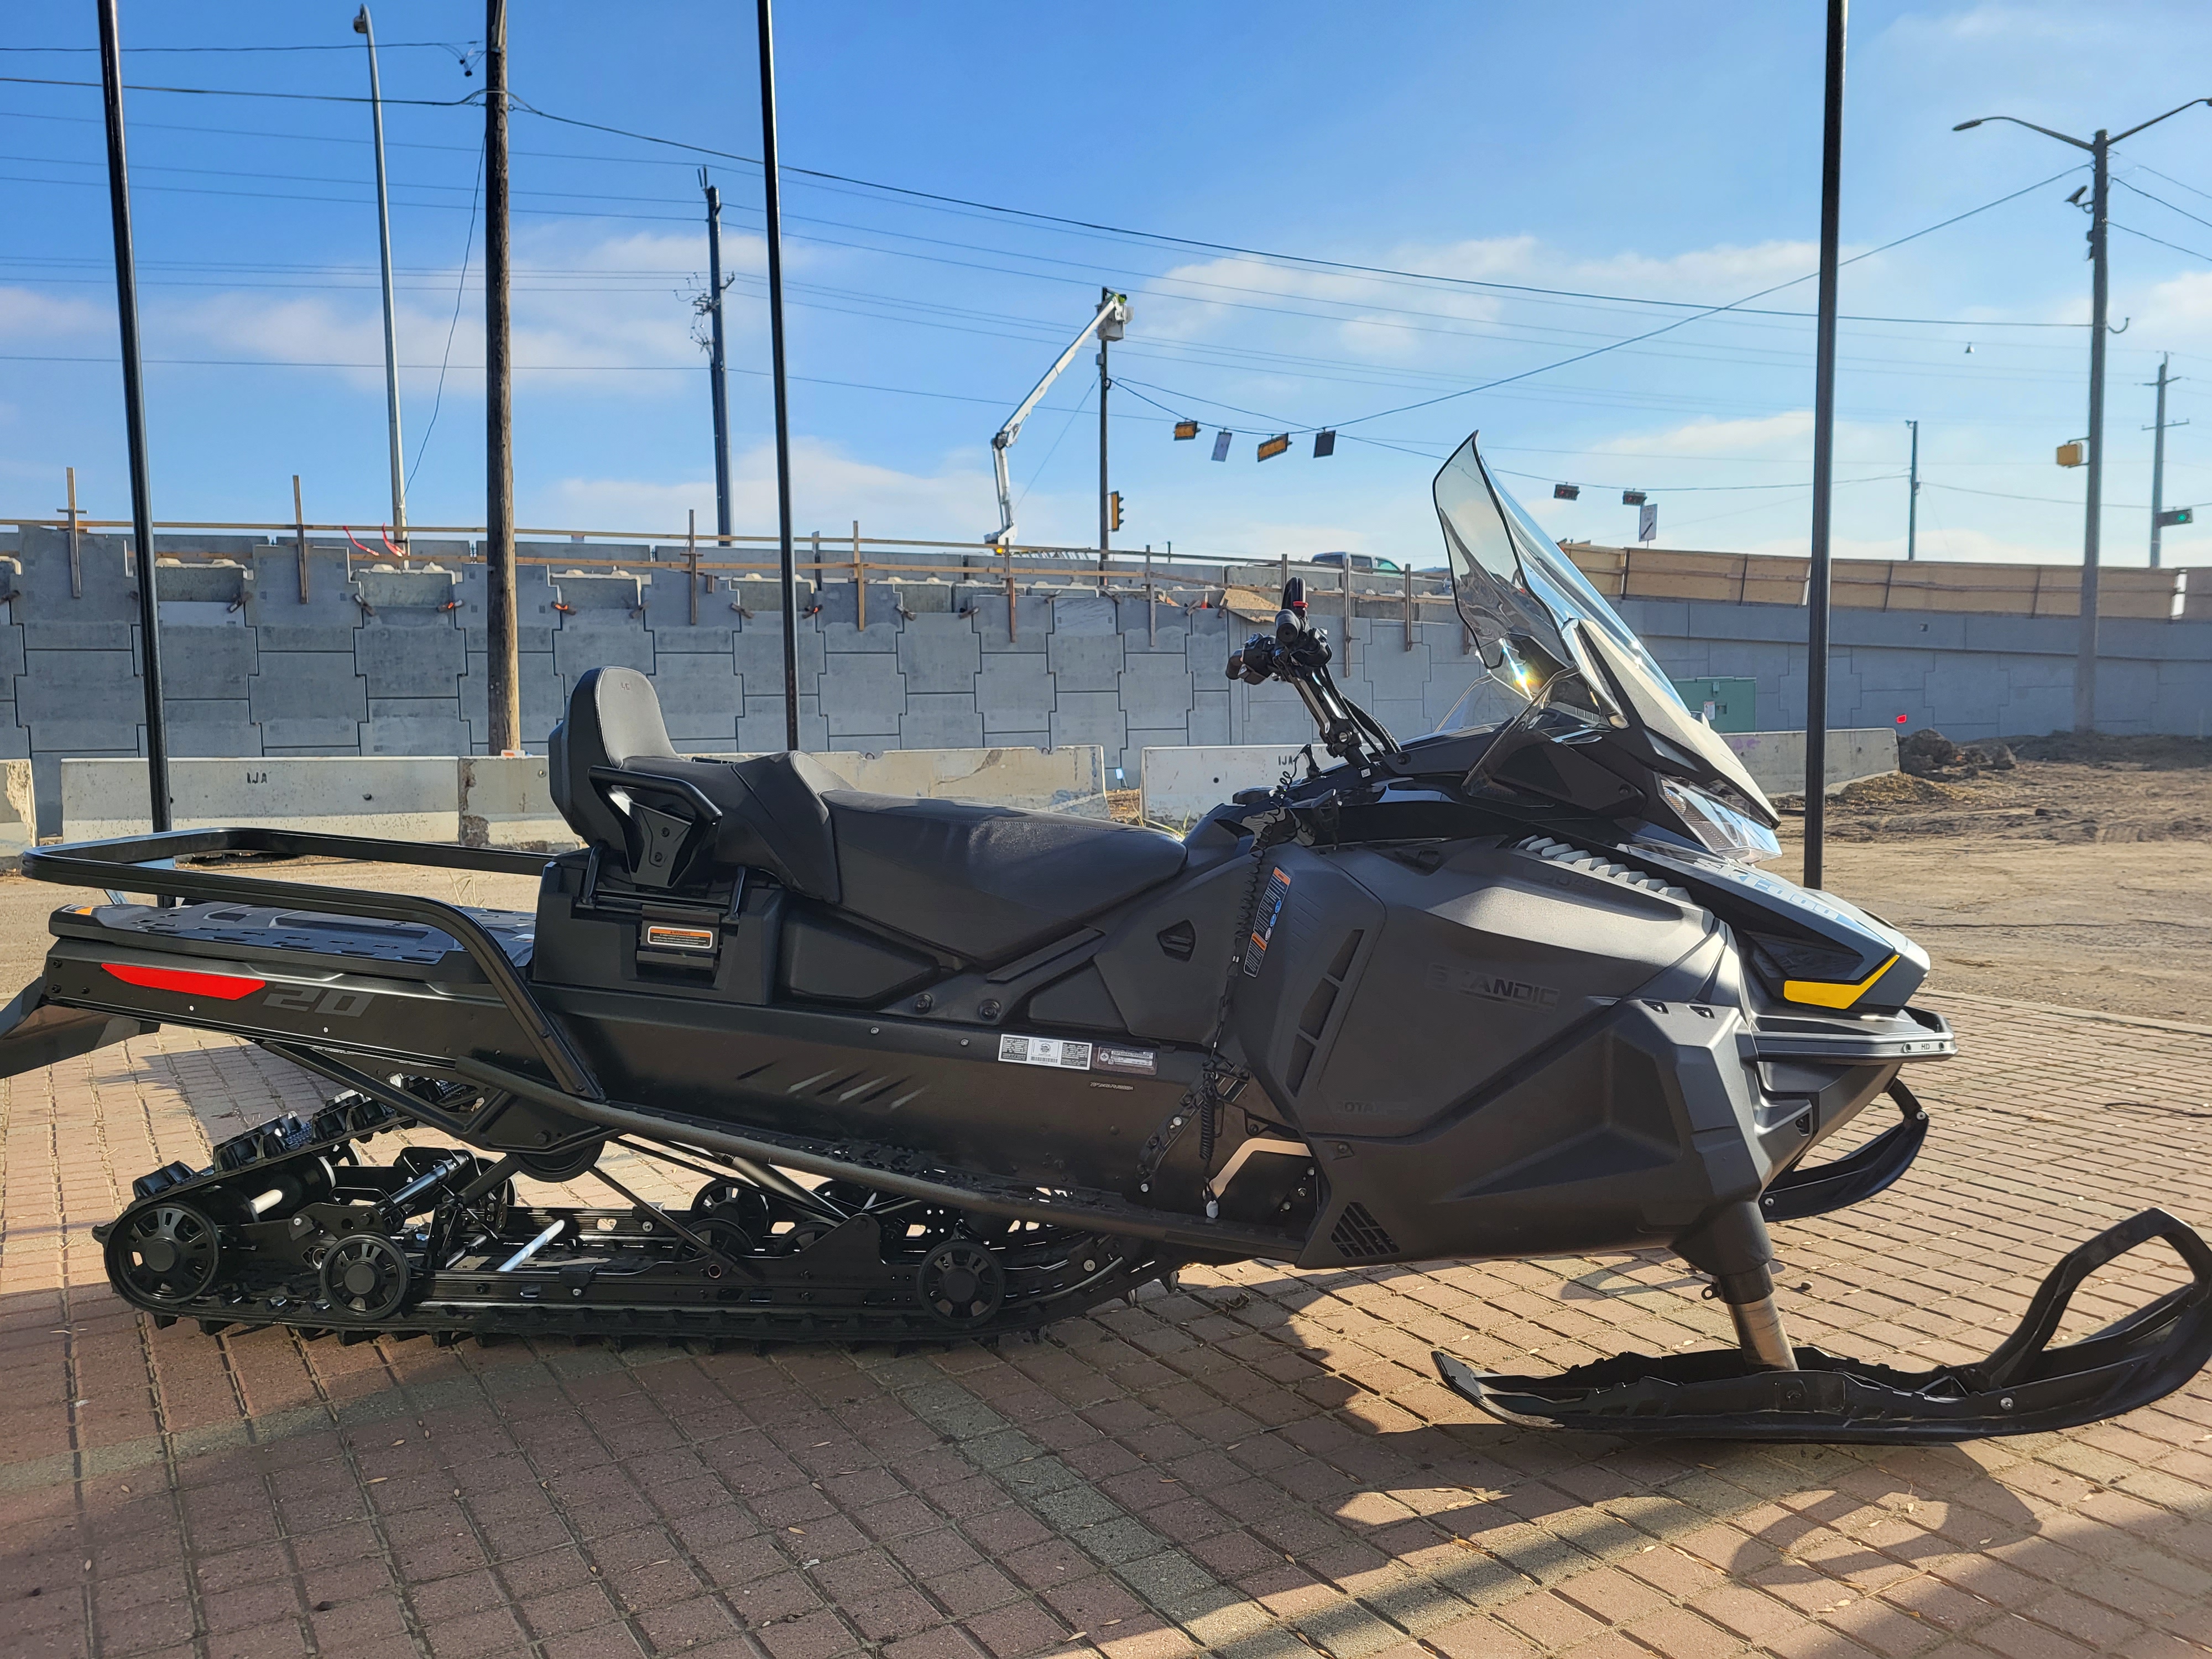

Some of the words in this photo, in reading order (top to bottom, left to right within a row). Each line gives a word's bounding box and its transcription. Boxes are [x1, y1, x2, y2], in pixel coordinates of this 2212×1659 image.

[262, 983, 376, 1018] 20
[1428, 963, 1559, 1008] SANDIC
[1336, 1100, 1385, 1113] ROTA
